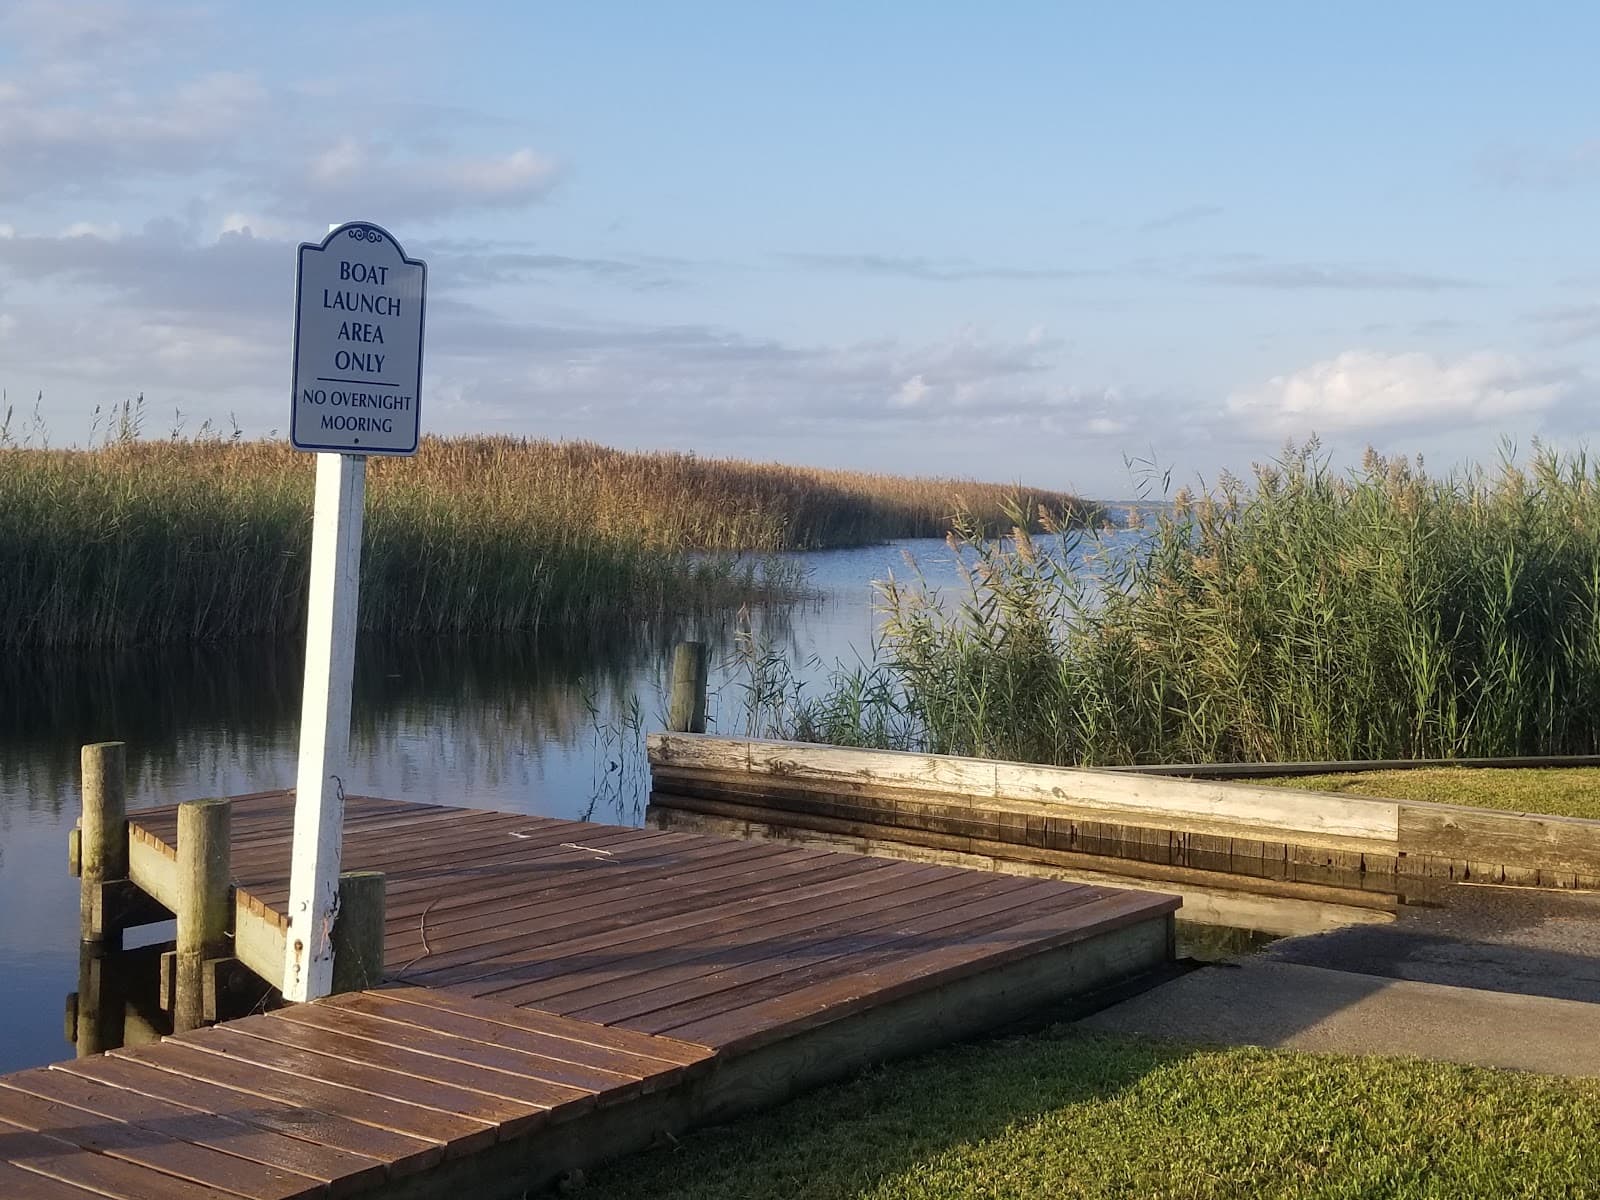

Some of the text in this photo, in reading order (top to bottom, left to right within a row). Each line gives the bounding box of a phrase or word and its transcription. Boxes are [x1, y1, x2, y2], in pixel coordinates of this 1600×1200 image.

[340, 261, 389, 286] BOAT
[323, 289, 401, 317] LAUNCH
[337, 321, 384, 344] AREA
[335, 350, 386, 373] ONLY
[303, 389, 412, 411] NO OVERNIGHT
[321, 415, 393, 433] MOORING
